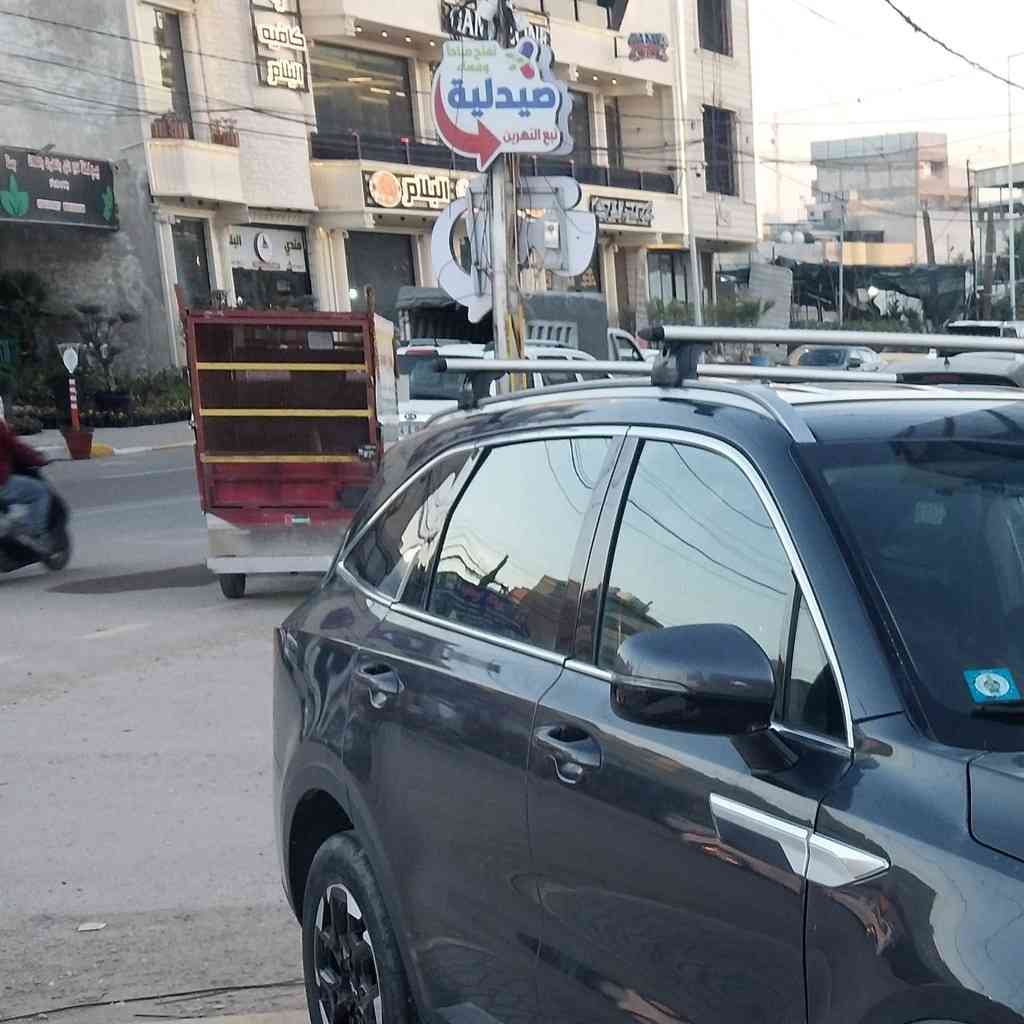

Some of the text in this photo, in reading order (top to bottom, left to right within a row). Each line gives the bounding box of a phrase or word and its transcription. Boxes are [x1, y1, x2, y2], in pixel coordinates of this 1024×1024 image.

[447, 78, 556, 118] صيدلية
[503, 128, 558, 146] نبع النهرين
